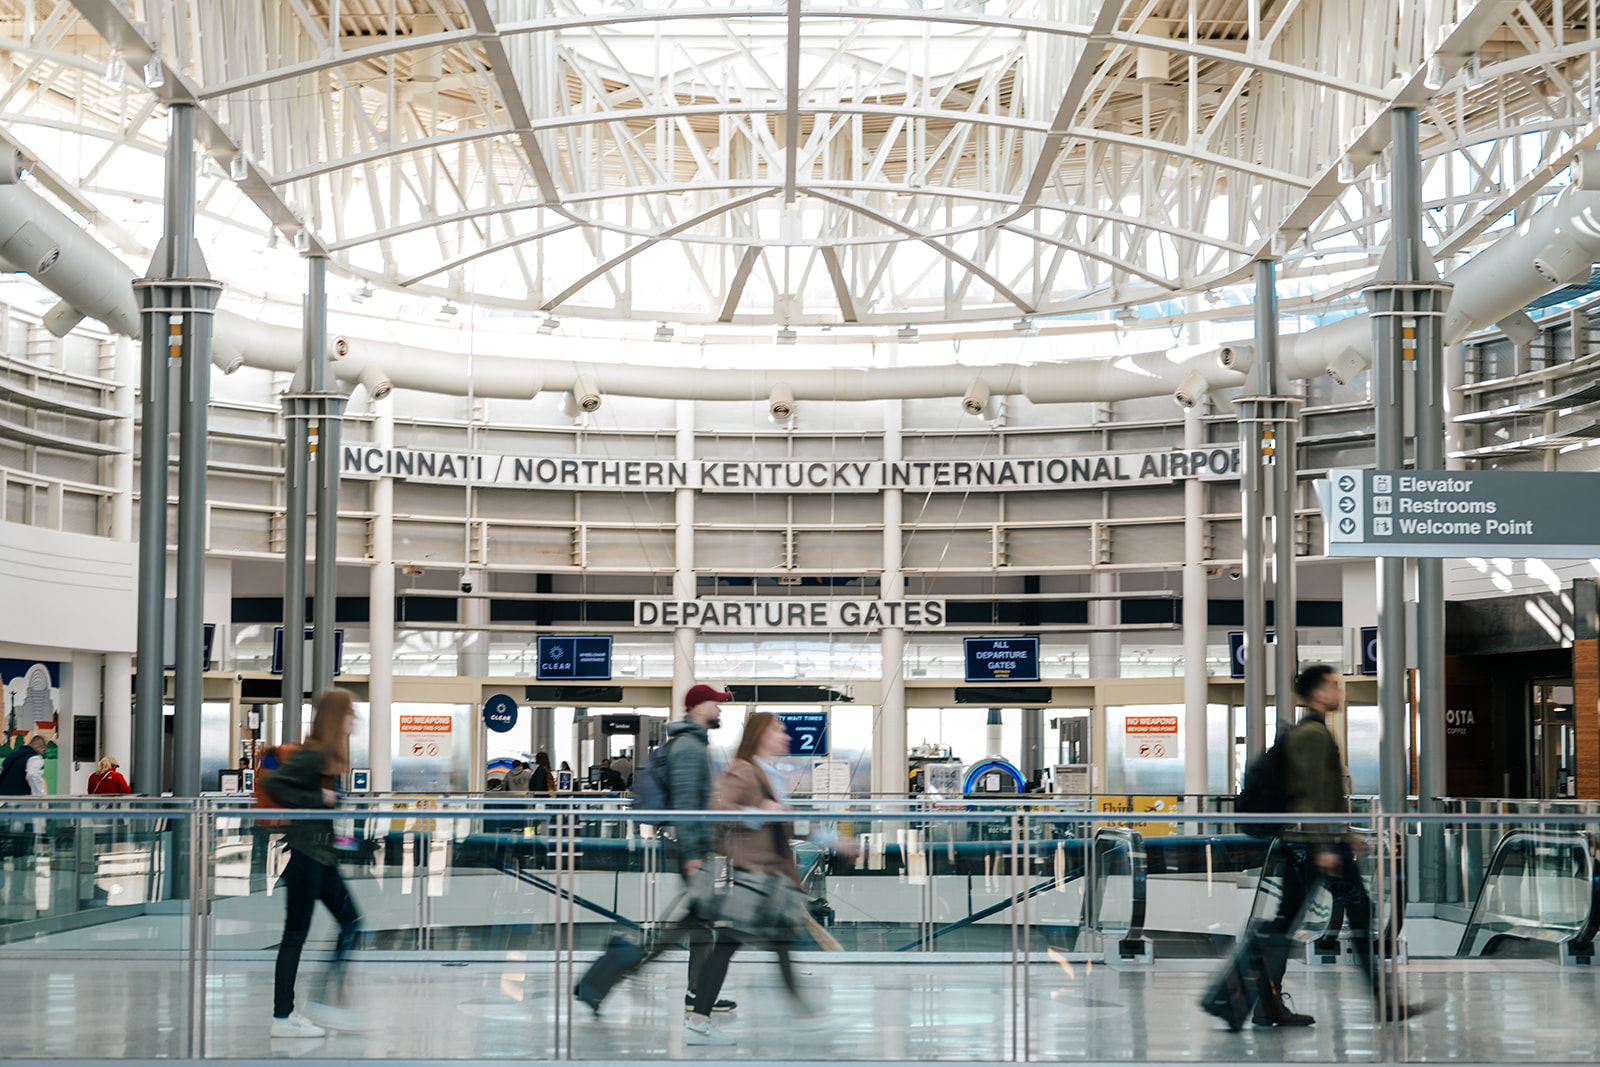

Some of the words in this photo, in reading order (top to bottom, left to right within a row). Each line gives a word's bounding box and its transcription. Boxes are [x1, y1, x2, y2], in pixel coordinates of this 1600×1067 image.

[514, 458, 687, 485] NORTHERN
[701, 463, 871, 487] KENTUCKY
[882, 457, 1129, 485] INTERNATIONAL
[1399, 477, 1472, 493] Elevator
[1399, 498, 1496, 514] Restrooms
[1399, 519, 1481, 535] Welcome
[1486, 520, 1533, 535] Point
[639, 601, 827, 626] DEPARTURE
[840, 601, 943, 626] GATES
[976, 650, 1028, 659] DEPARTURE
[987, 661, 1016, 669] GATES
[401, 716, 413, 724] NO
[414, 716, 450, 724] WEAPONS
[1446, 709, 1475, 726] OSTA
[800, 734, 814, 750] 2
